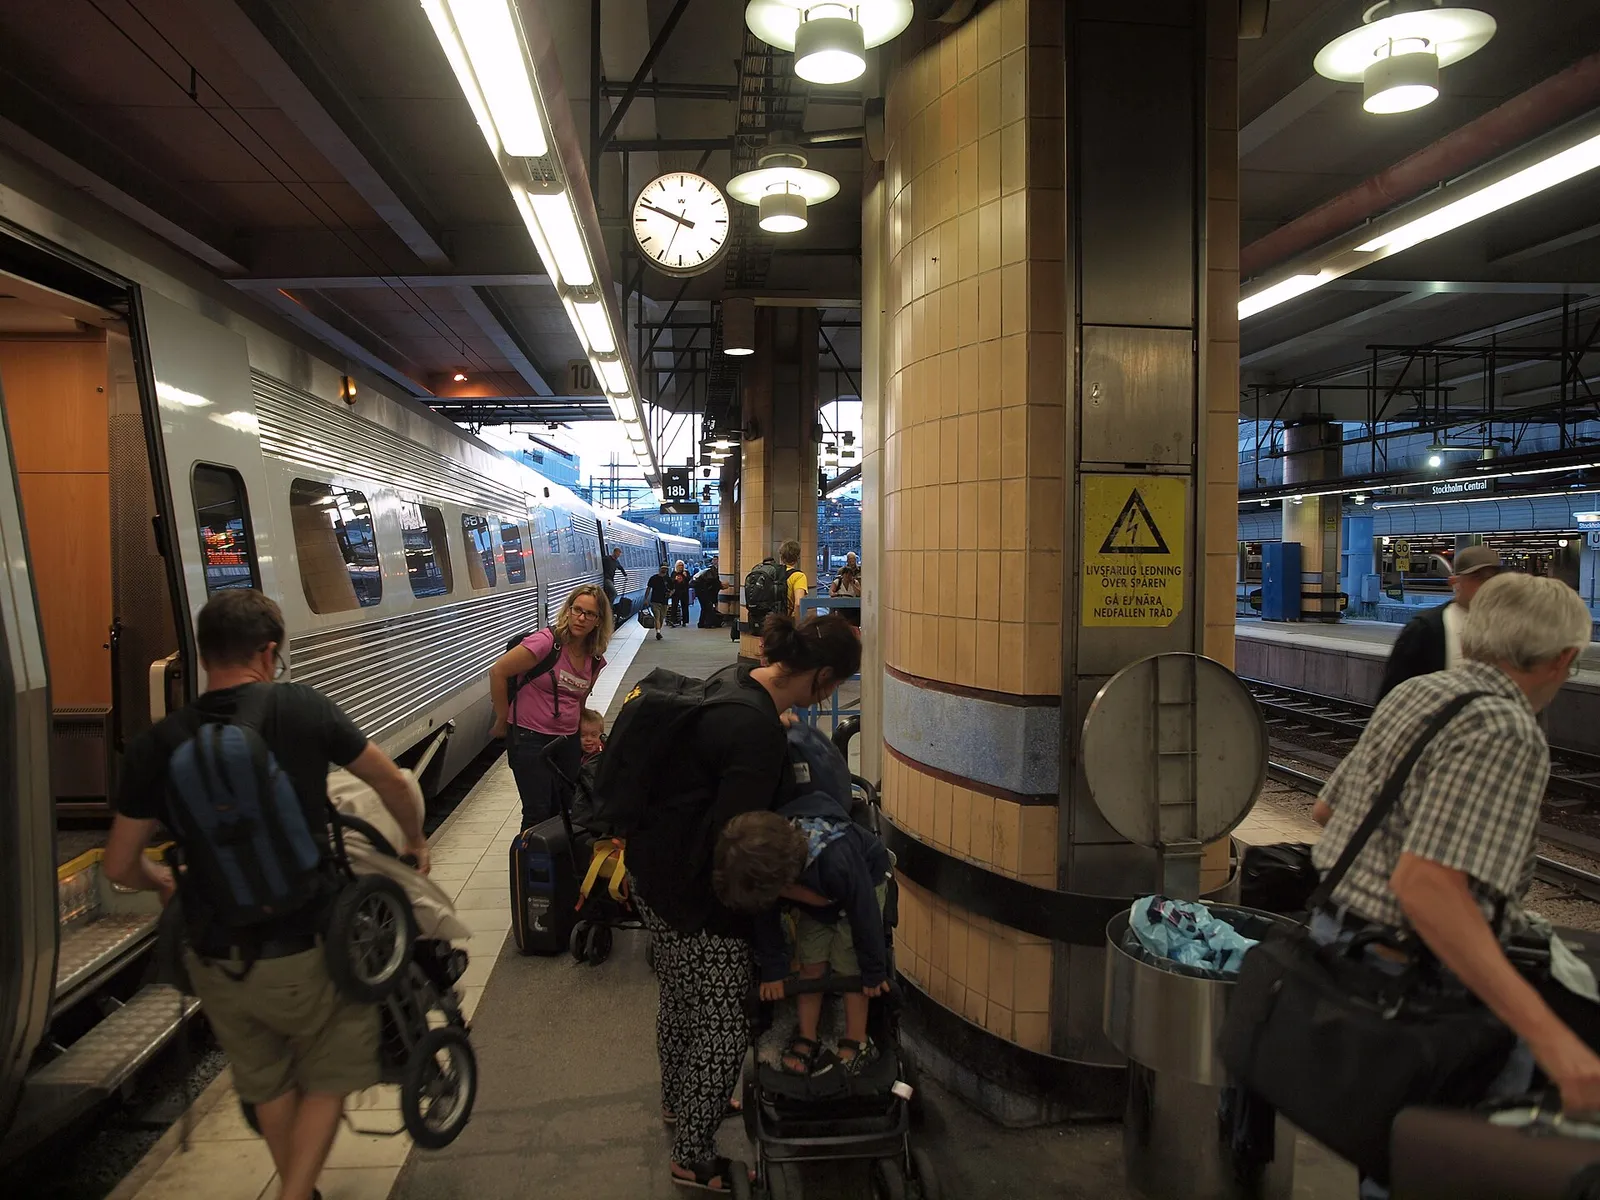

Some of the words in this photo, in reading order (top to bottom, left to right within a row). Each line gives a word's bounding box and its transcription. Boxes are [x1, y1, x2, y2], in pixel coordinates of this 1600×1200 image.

[667, 485, 686, 497] 18b
[1432, 482, 1463, 495] Stockholm
[1464, 480, 1487, 491] Central
[1396, 544, 1409, 553] 30
[1086, 565, 1137, 576] LIVSFARLIG
[1140, 565, 1181, 576] LEDNING
[1101, 575, 1127, 588] ÖVER
[1130, 575, 1166, 588] SPÅREN
[1104, 593, 1119, 606] GÅ
[1122, 595, 1132, 606] EJ
[1135, 593, 1163, 606] NÄRA
[1093, 607, 1146, 618] NEDFALLEN
[1150, 605, 1173, 618] TRÅD
